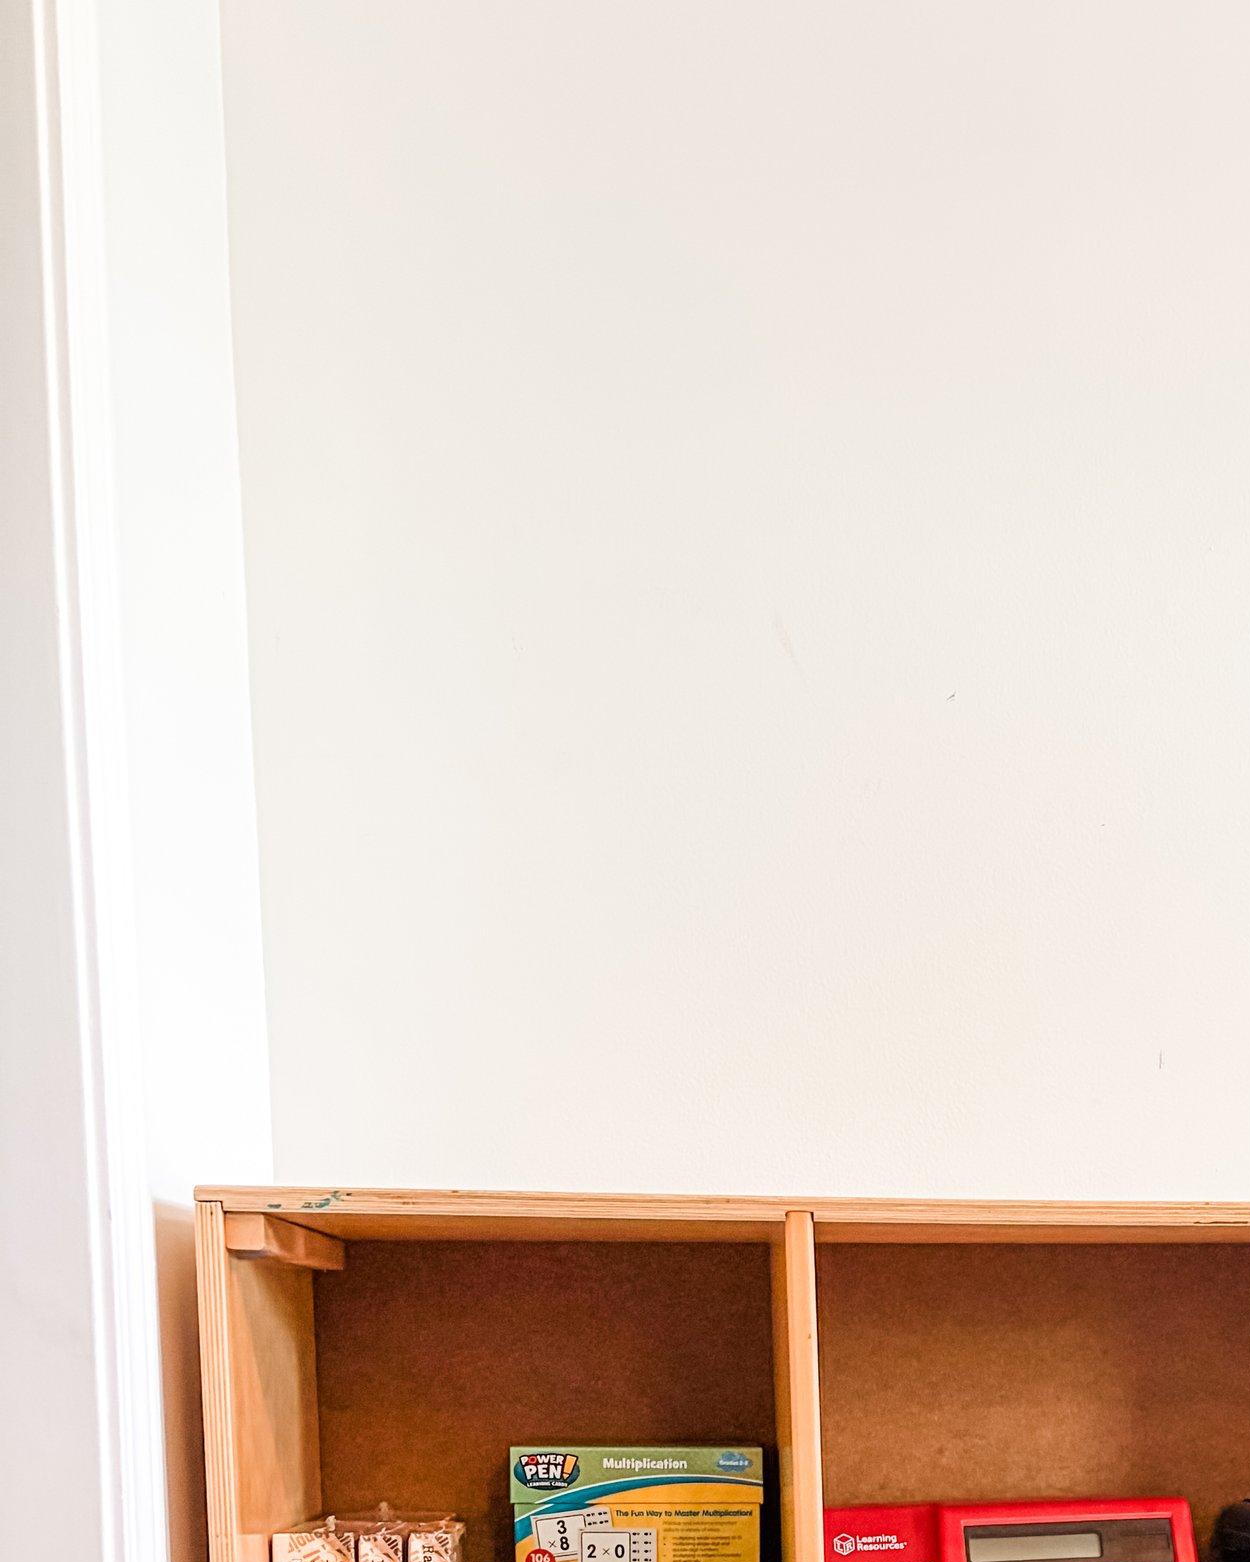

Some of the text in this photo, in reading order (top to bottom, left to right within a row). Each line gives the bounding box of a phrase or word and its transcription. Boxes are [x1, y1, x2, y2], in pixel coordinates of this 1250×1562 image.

[520, 1454, 564, 1465] POWER
[602, 1458, 688, 1472] Multiplication
[646, 1510, 662, 1518] Way
[702, 1510, 753, 1518] Multiplication!
[556, 1520, 567, 1534] 3
[560, 1536, 569, 1550] 8
[856, 1534, 897, 1543] Learning
[587, 1544, 597, 1558] 2
[614, 1544, 625, 1558] 0
[857, 1543, 905, 1551] Resources
[530, 1553, 551, 1562] 106
